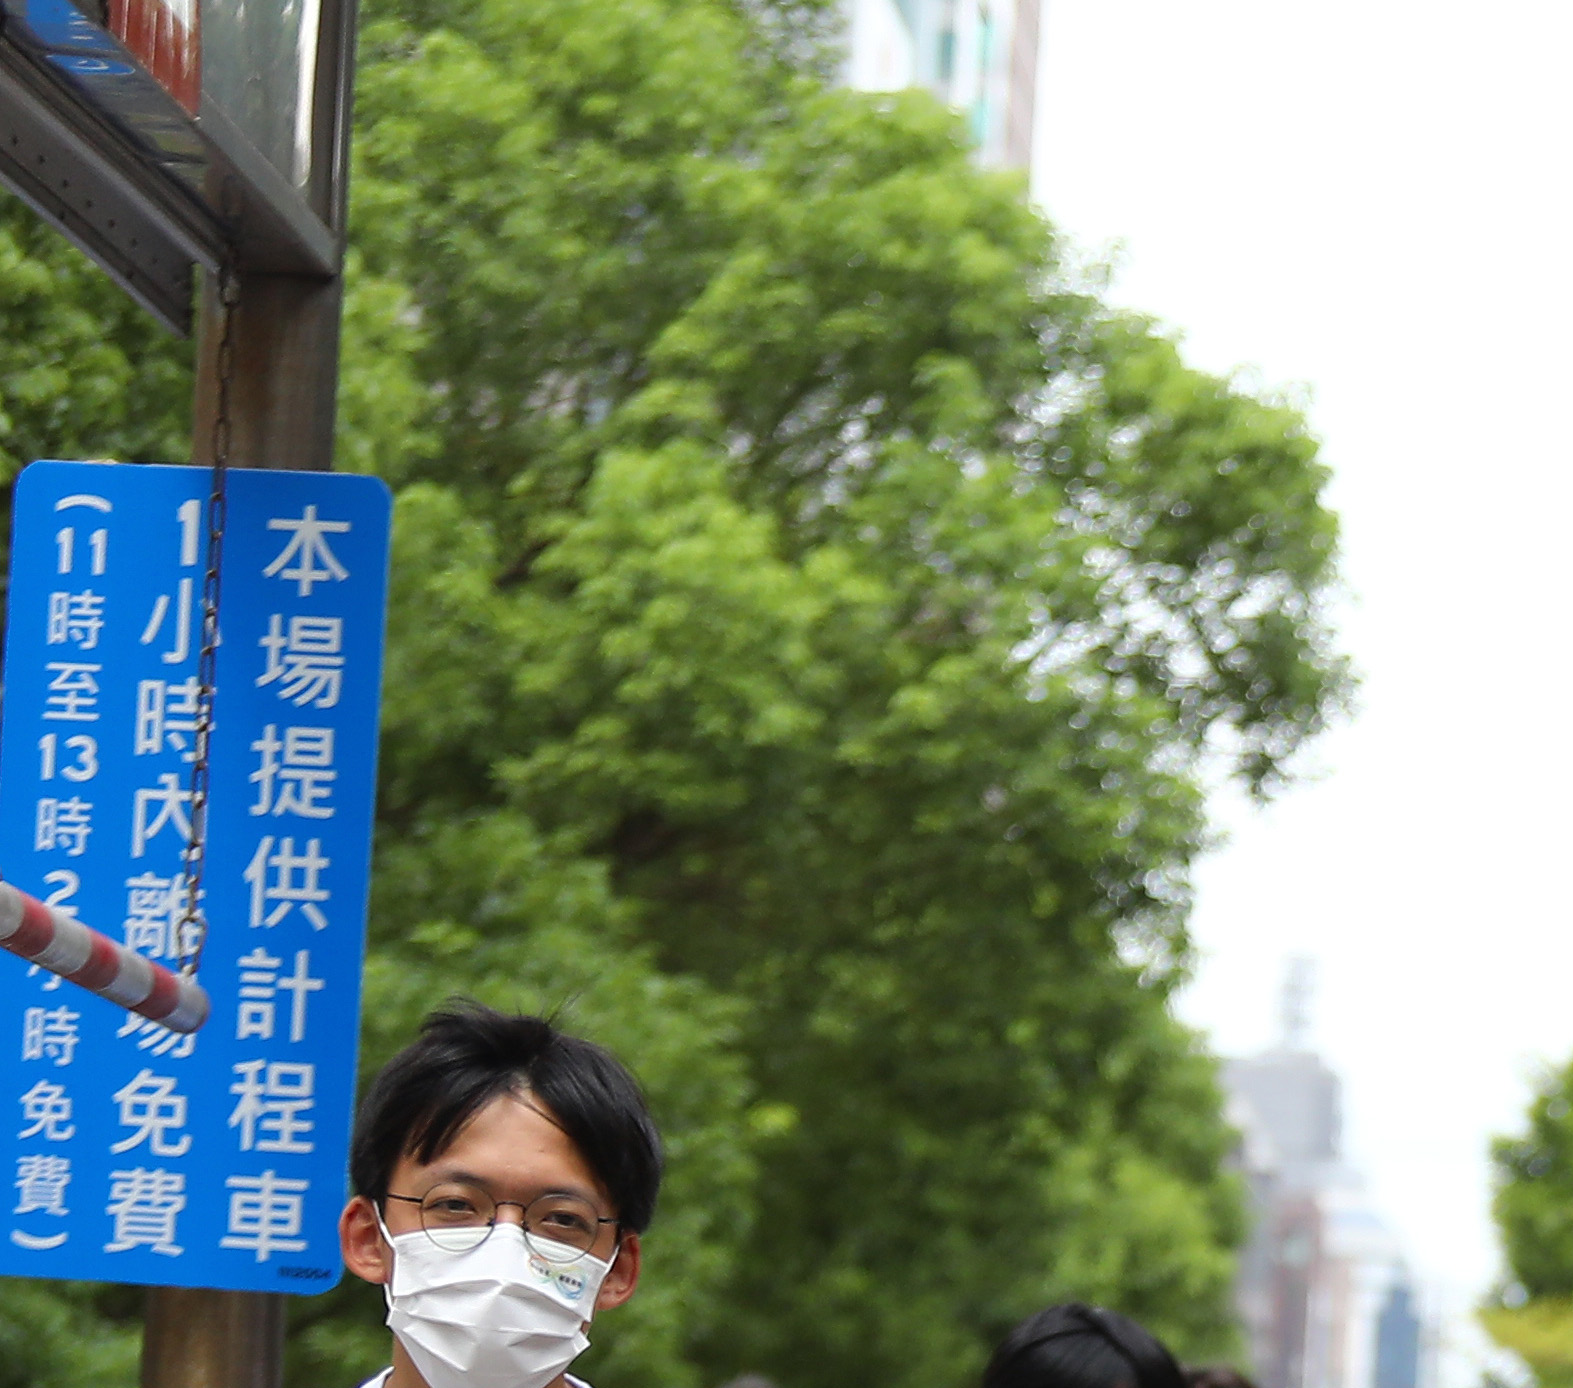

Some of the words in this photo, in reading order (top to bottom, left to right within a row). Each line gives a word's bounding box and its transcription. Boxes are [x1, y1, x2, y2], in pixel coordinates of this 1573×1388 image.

[11, 494, 114, 1251] (11時至13時2時免費)
[220, 505, 352, 1264] 本場提供計程車
